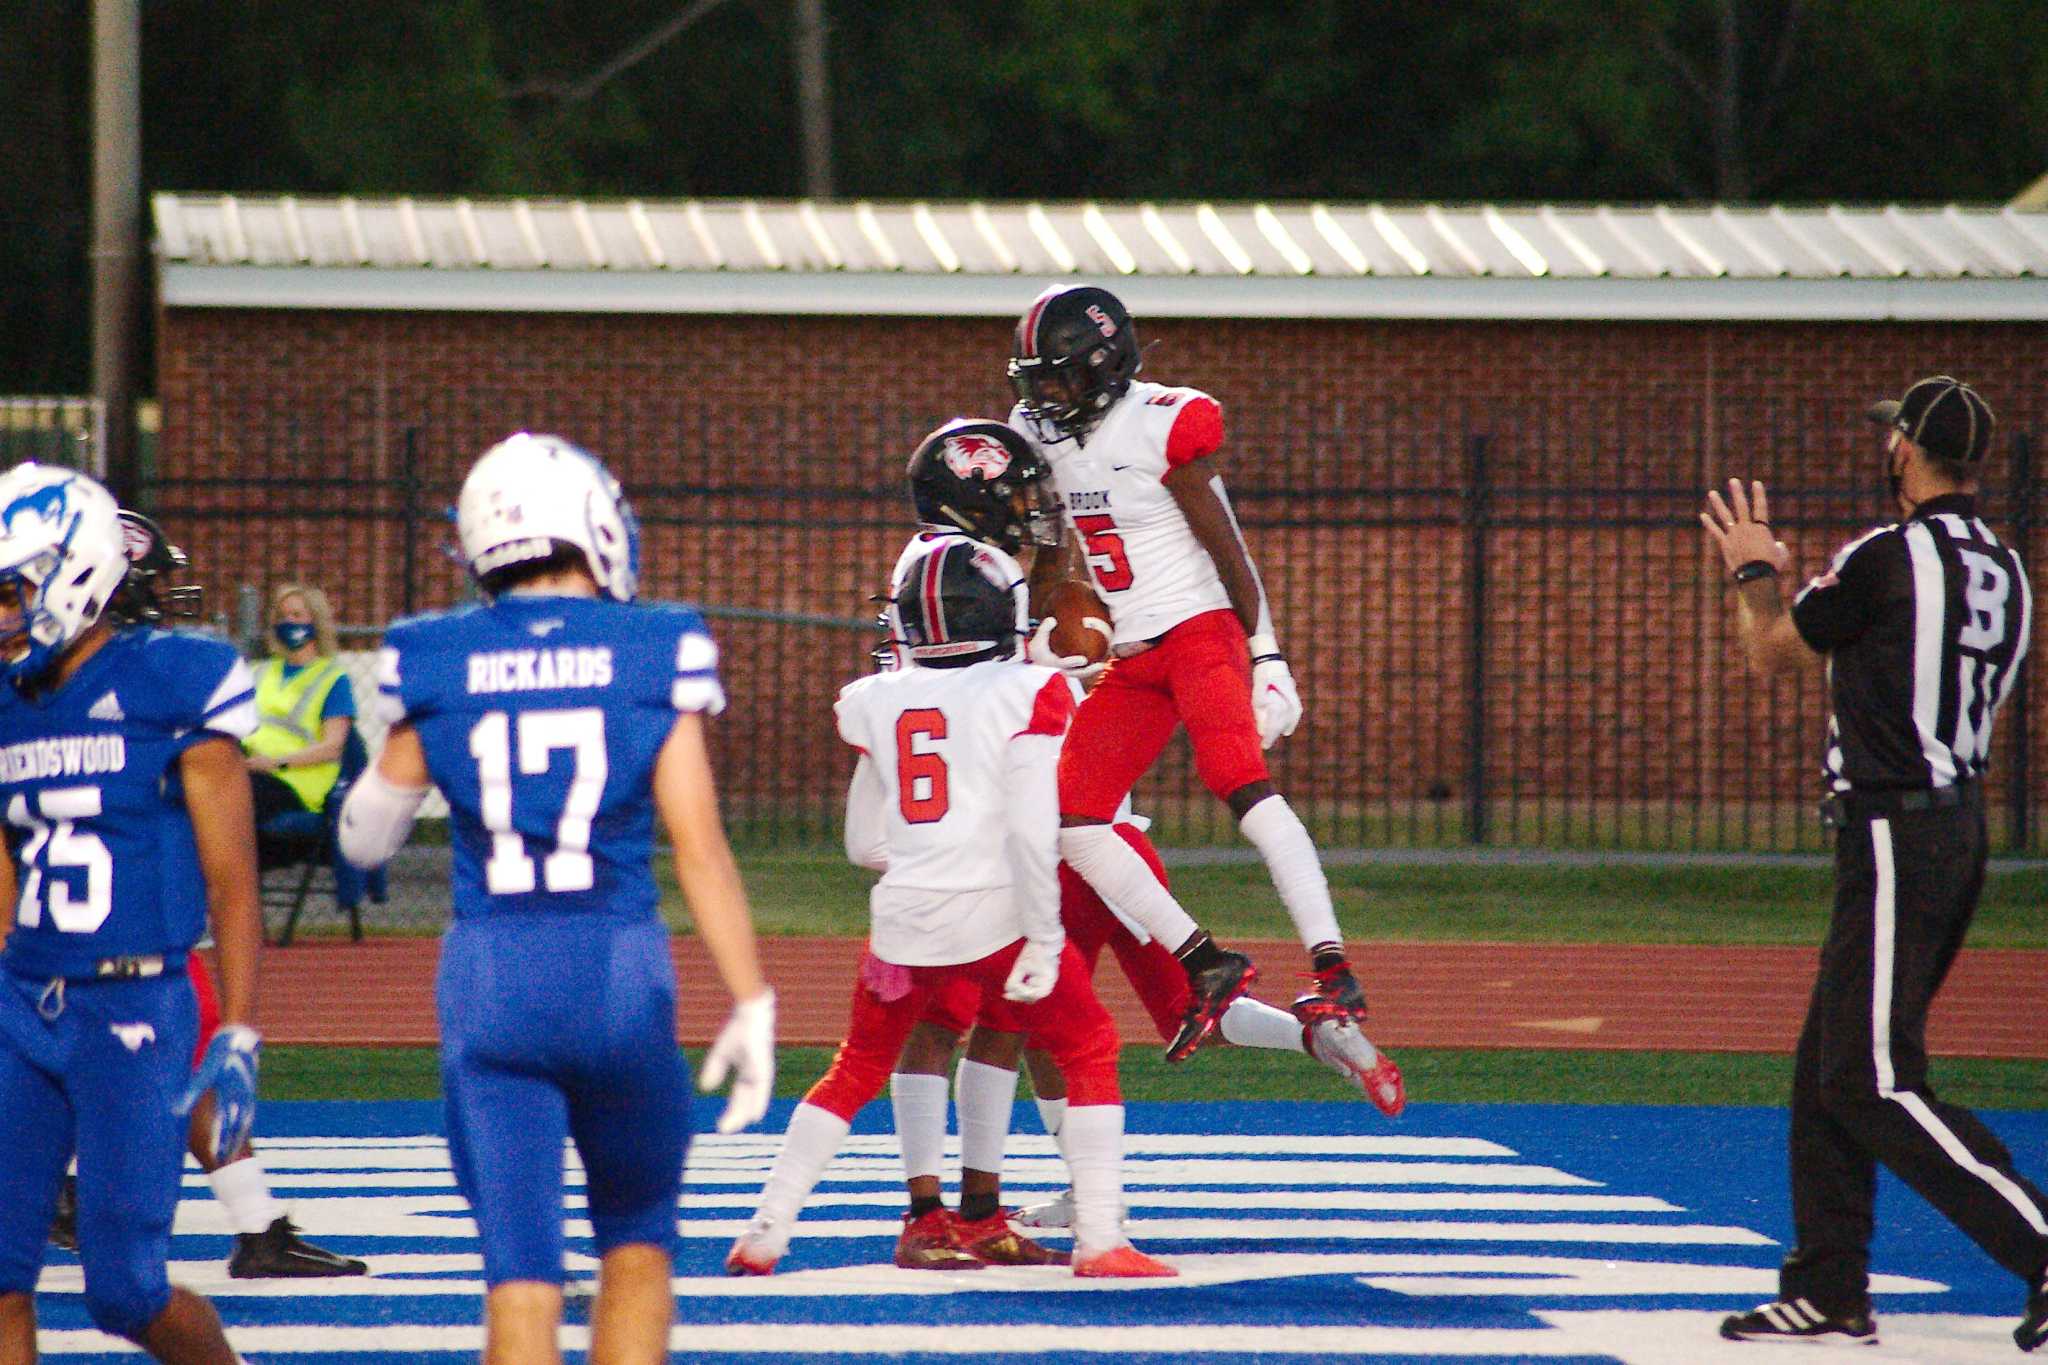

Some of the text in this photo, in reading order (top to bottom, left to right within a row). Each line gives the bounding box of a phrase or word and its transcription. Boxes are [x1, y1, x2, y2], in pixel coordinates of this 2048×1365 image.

[1069, 490, 1112, 510] BROOK
[1072, 514, 1134, 592] 5
[1958, 548, 2010, 651] B
[467, 647, 613, 693] RICKARDS
[469, 708, 609, 893] 17
[896, 707, 948, 824] 6
[7, 785, 113, 933] 15
